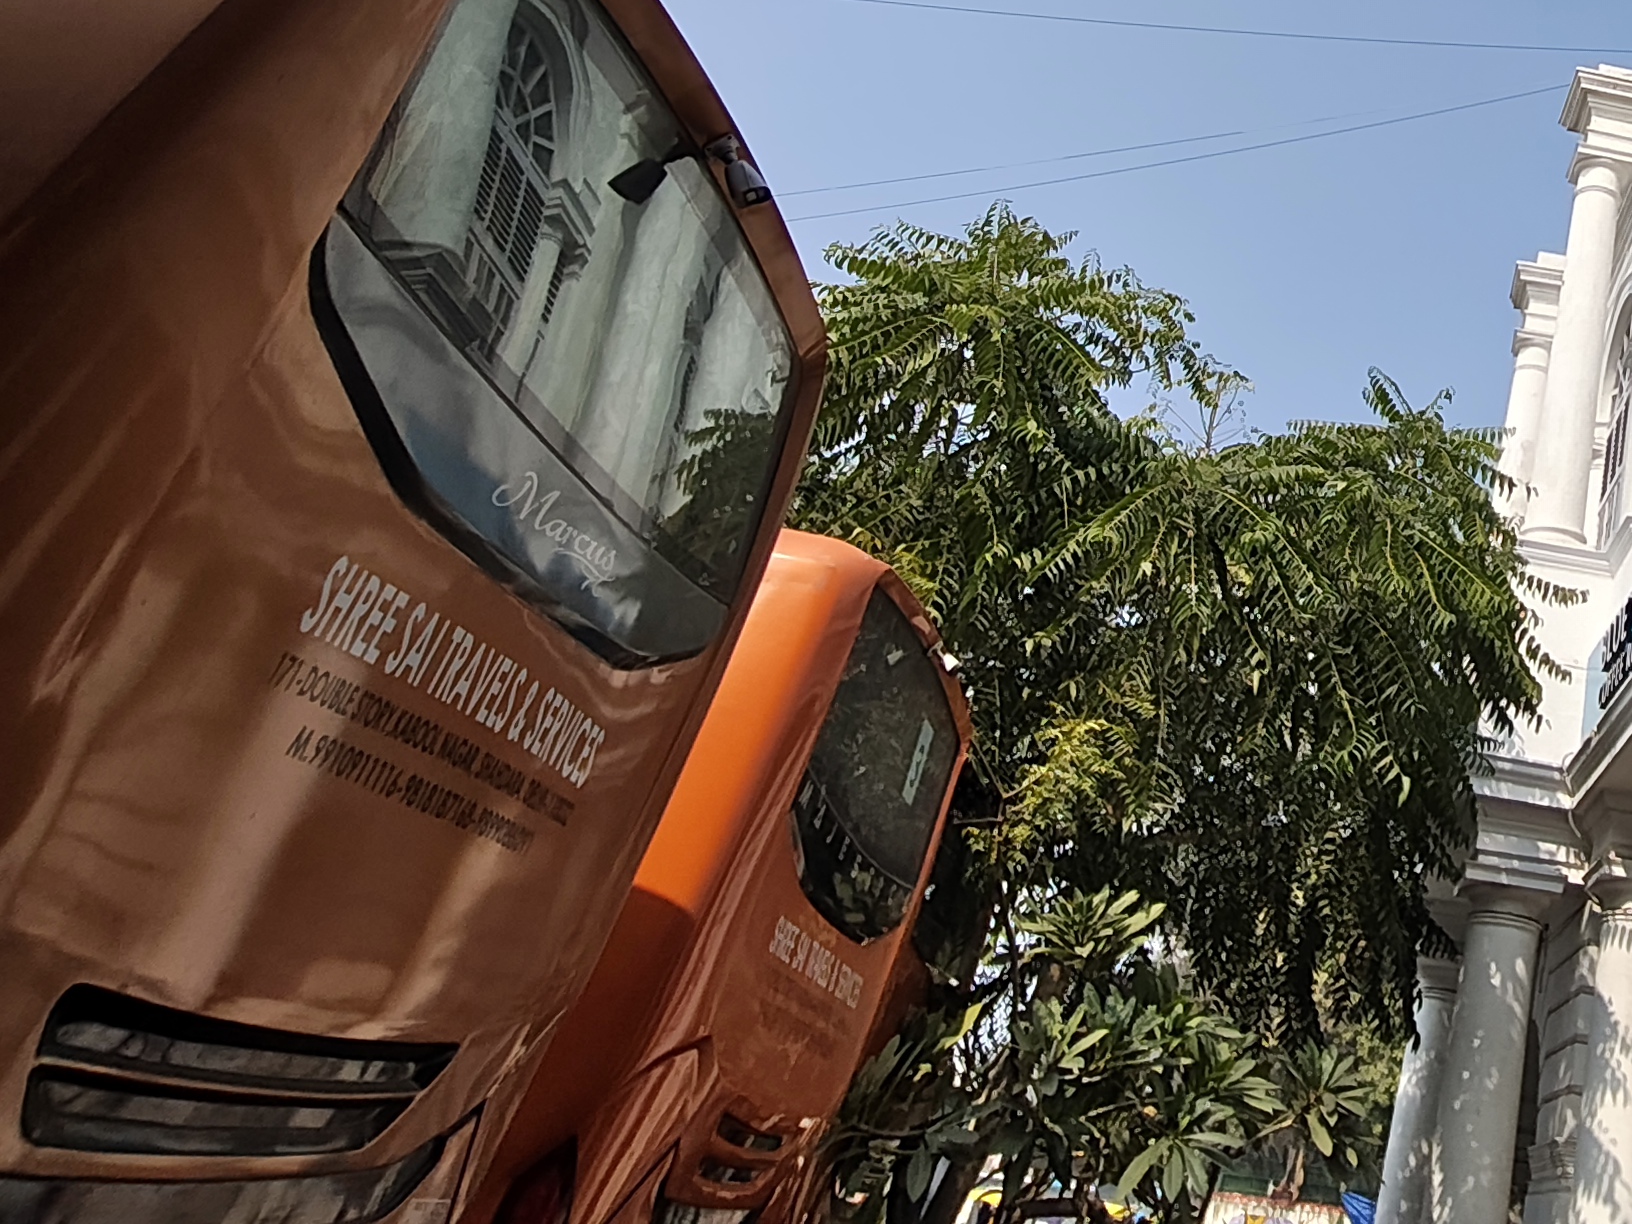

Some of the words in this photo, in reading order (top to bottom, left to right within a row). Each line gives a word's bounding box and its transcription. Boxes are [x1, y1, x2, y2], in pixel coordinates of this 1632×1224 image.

[491, 470, 618, 573] Marcus
[300, 555, 410, 665] SHREE
[384, 602, 451, 687] SAI
[1600, 606, 1629, 668] BLUE
[268, 651, 361, 717] 171-DOUBLE
[426, 625, 529, 734] TRAVELS
[507, 680, 541, 742] &
[523, 687, 606, 789] SERVICES
